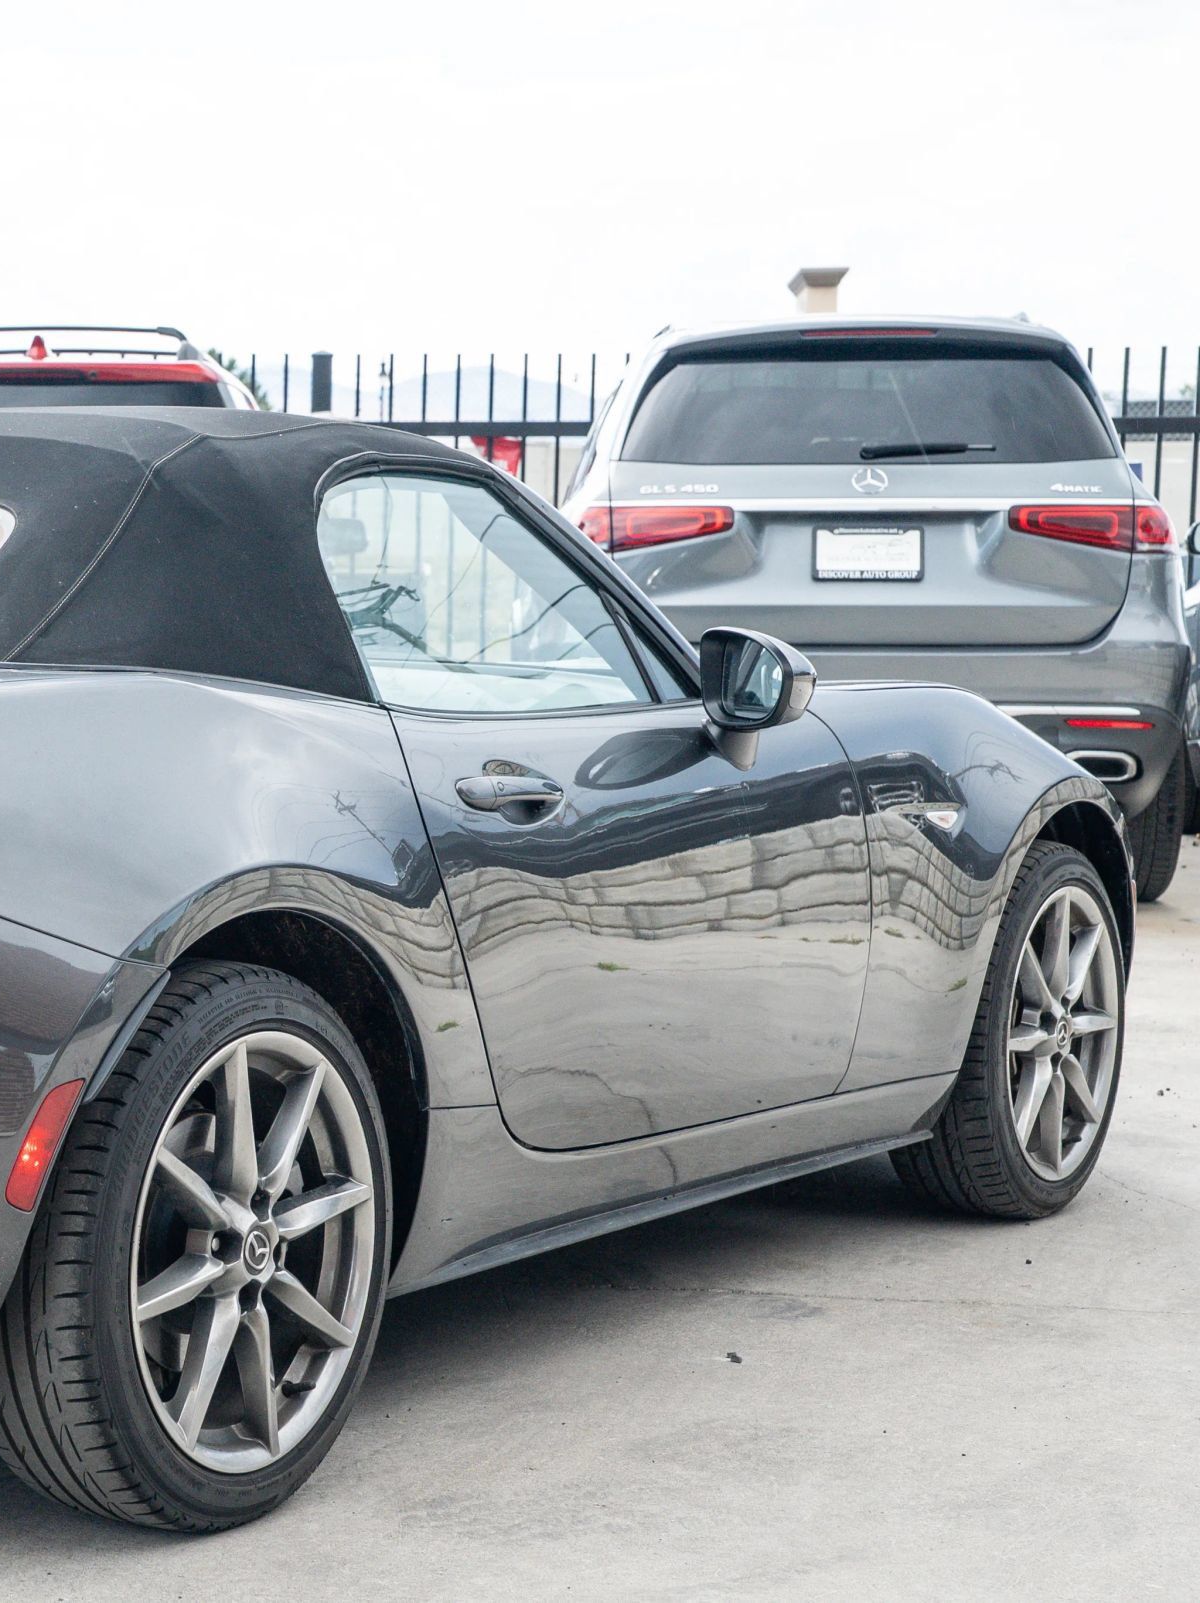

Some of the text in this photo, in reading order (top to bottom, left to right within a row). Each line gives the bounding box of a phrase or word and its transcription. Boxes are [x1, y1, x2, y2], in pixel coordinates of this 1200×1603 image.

[680, 483, 720, 494] 450
[1050, 483, 1103, 494] 4MATIC
[862, 569, 887, 579] AUTO
[888, 569, 918, 579] GROUP
